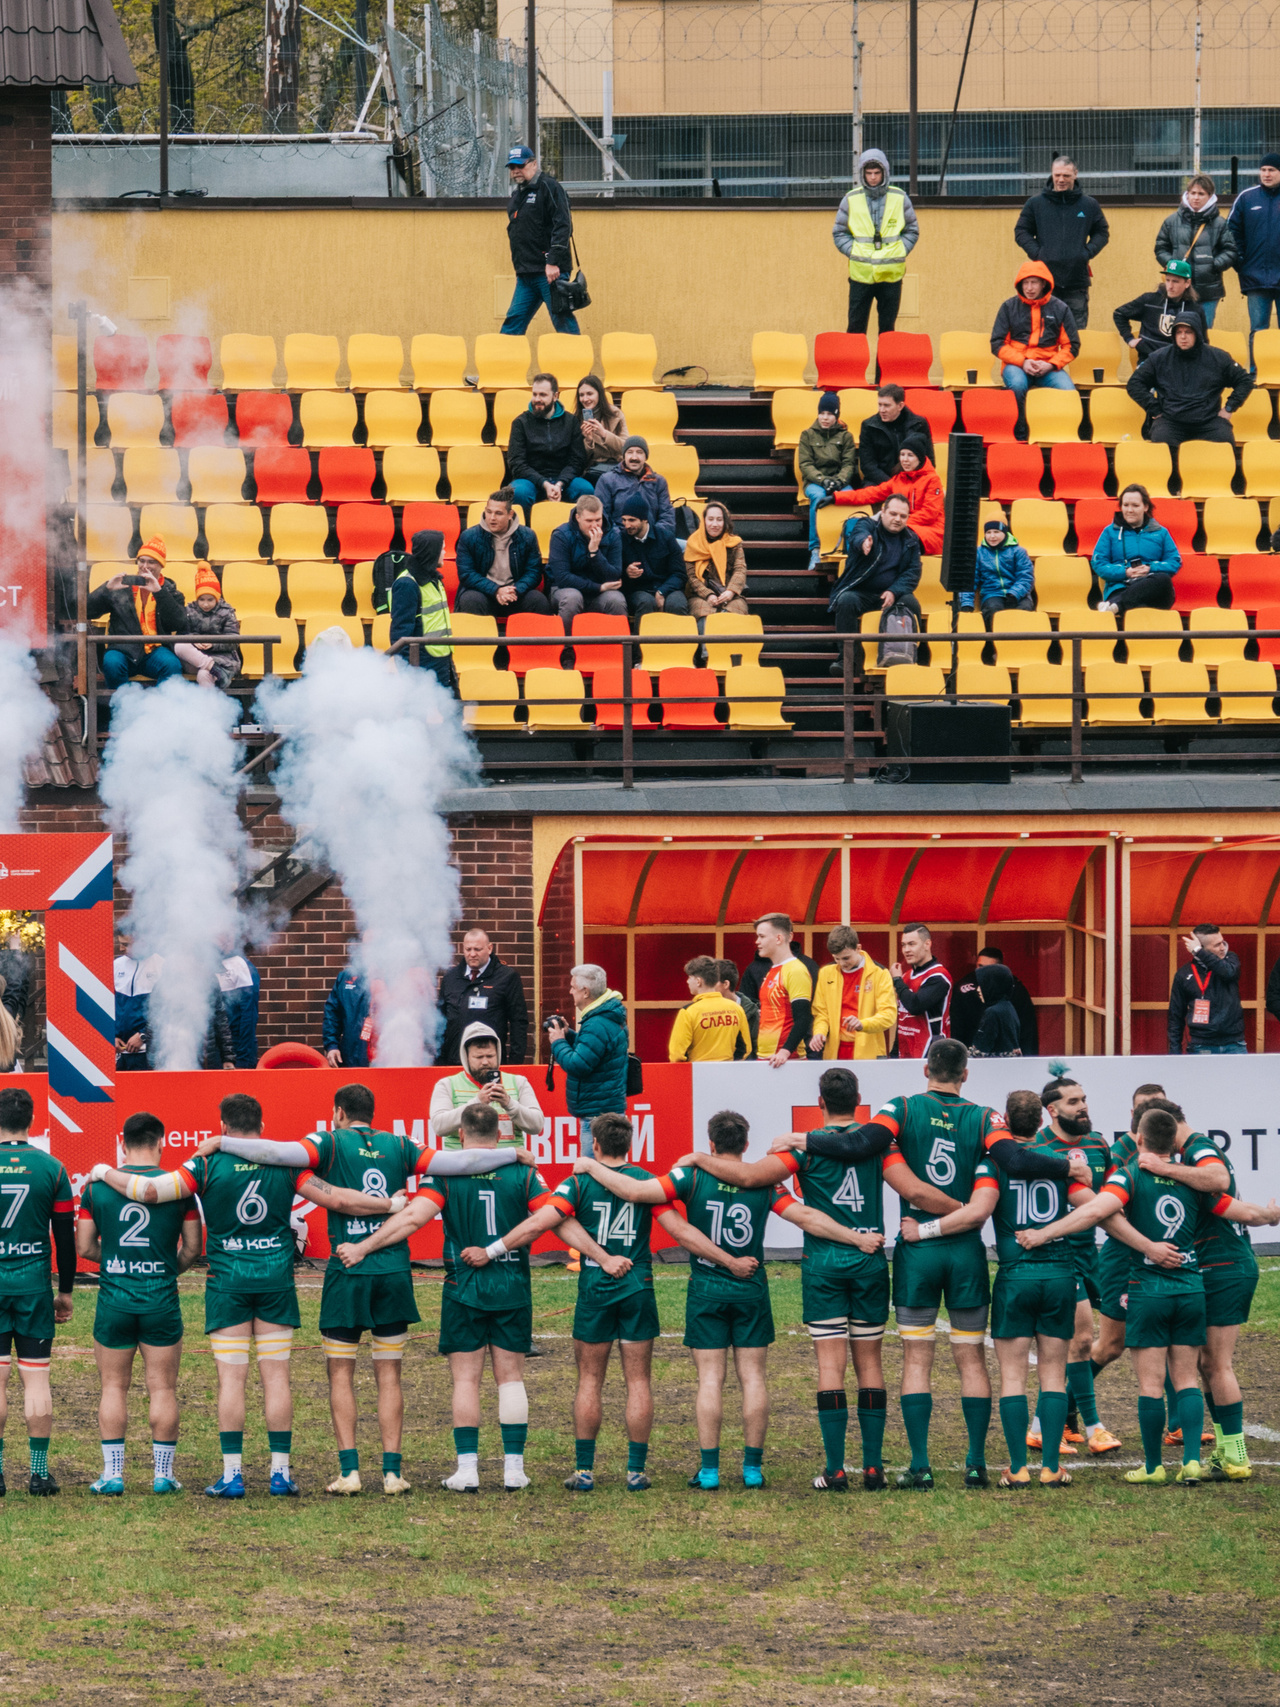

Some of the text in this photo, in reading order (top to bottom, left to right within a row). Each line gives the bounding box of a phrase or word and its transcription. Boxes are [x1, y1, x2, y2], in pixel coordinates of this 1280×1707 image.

[700, 1015, 739, 1030] СЛАВА
[361, 1168, 390, 1199] 8
[925, 1138, 956, 1186] 5
[0, 1184, 30, 1229] 7
[236, 1179, 268, 1225] 6
[832, 1167, 865, 1212] 4
[1009, 1179, 1059, 1225] 10
[119, 1202, 151, 1247] 2
[478, 1190, 497, 1236] 1
[592, 1201, 637, 1247] 14
[705, 1200, 754, 1248] 13
[1155, 1194, 1186, 1239] 9
